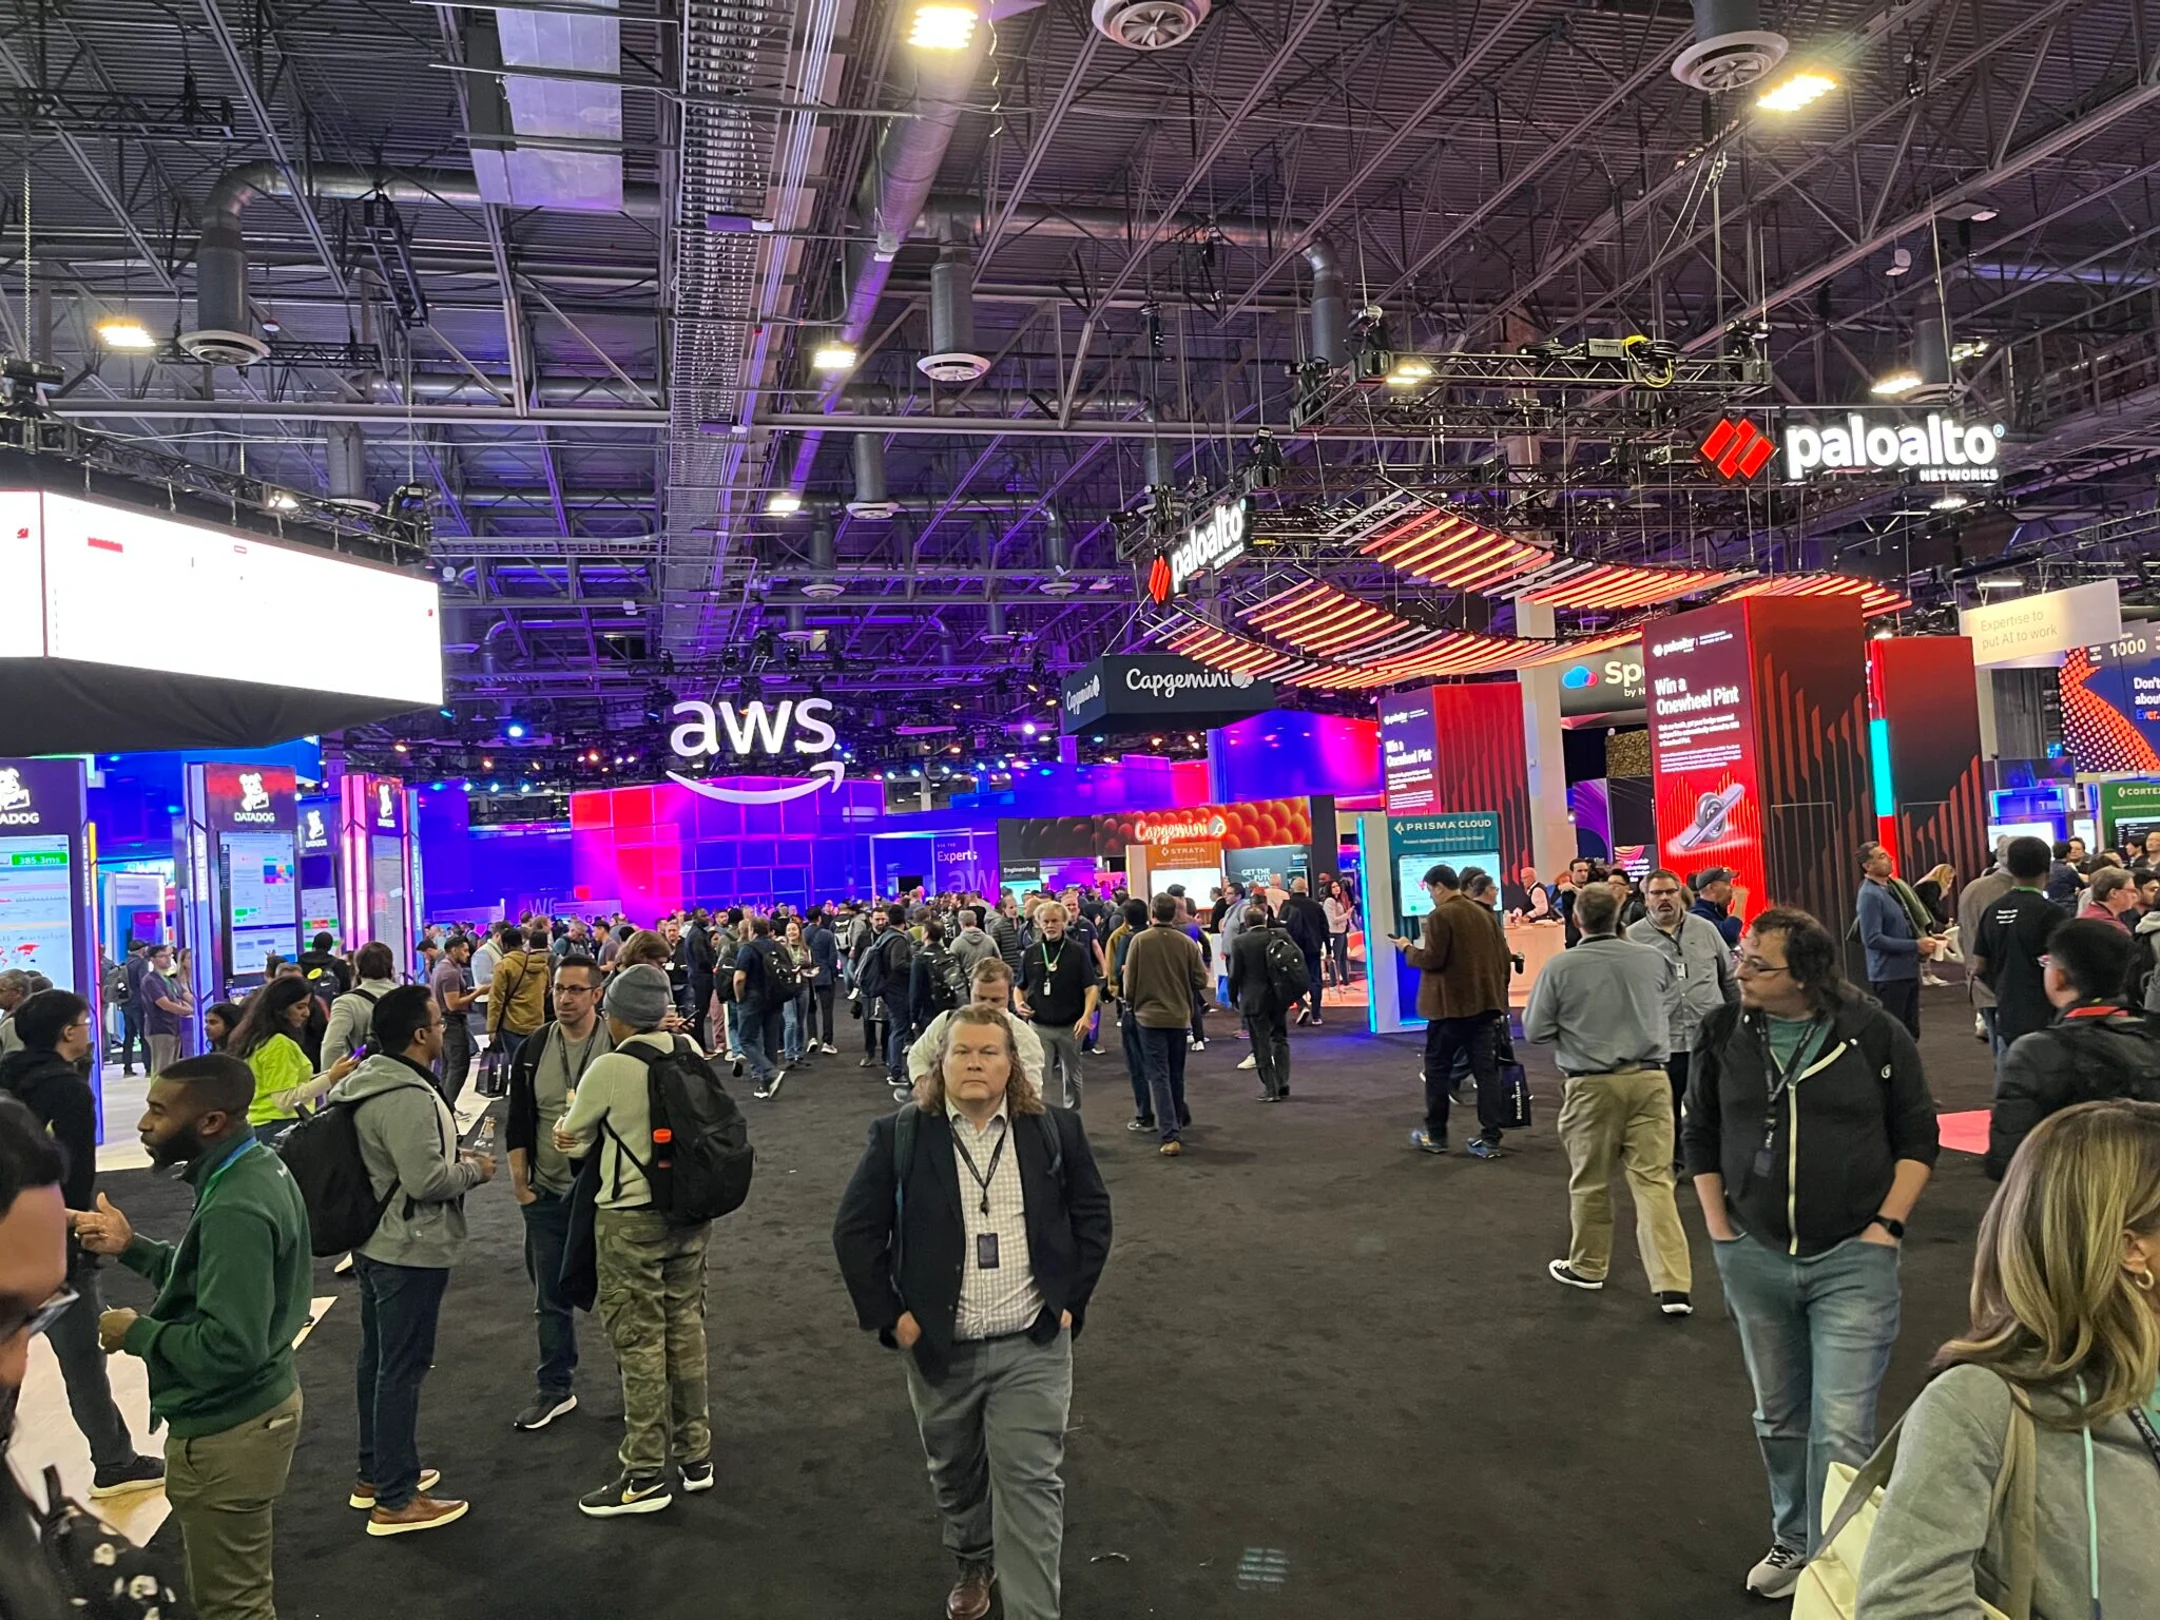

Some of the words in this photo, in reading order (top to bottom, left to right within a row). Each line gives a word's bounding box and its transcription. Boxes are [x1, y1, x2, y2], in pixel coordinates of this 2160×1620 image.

[1786, 413, 1997, 479] paloalto
[1919, 468, 1999, 482] NETWORKS
[1172, 504, 1243, 593] paloalto
[1980, 613, 2031, 632] Expertise
[2032, 610, 2044, 622] to
[1982, 635, 2000, 651] put
[2002, 632, 2014, 645] AI
[2017, 631, 2028, 641] to
[2031, 624, 2059, 639] work
[2109, 638, 2147, 658] 1000
[1126, 668, 1232, 698] Capgemini
[1624, 688, 1637, 698] by
[1638, 687, 1646, 696] N
[1654, 676, 1678, 696] Win
[1678, 677, 1687, 692] a
[1656, 688, 1712, 716] Onewheel
[1713, 685, 1739, 707] Pint
[670, 697, 836, 757] aws
[234, 812, 275, 822] DATADOG
[1406, 821, 1456, 831] PRISMA
[1458, 819, 1492, 829] CLOUD
[1134, 818, 1208, 845] Capgemini
[937, 849, 978, 864] Experts
[1170, 846, 1206, 855] STRATA
